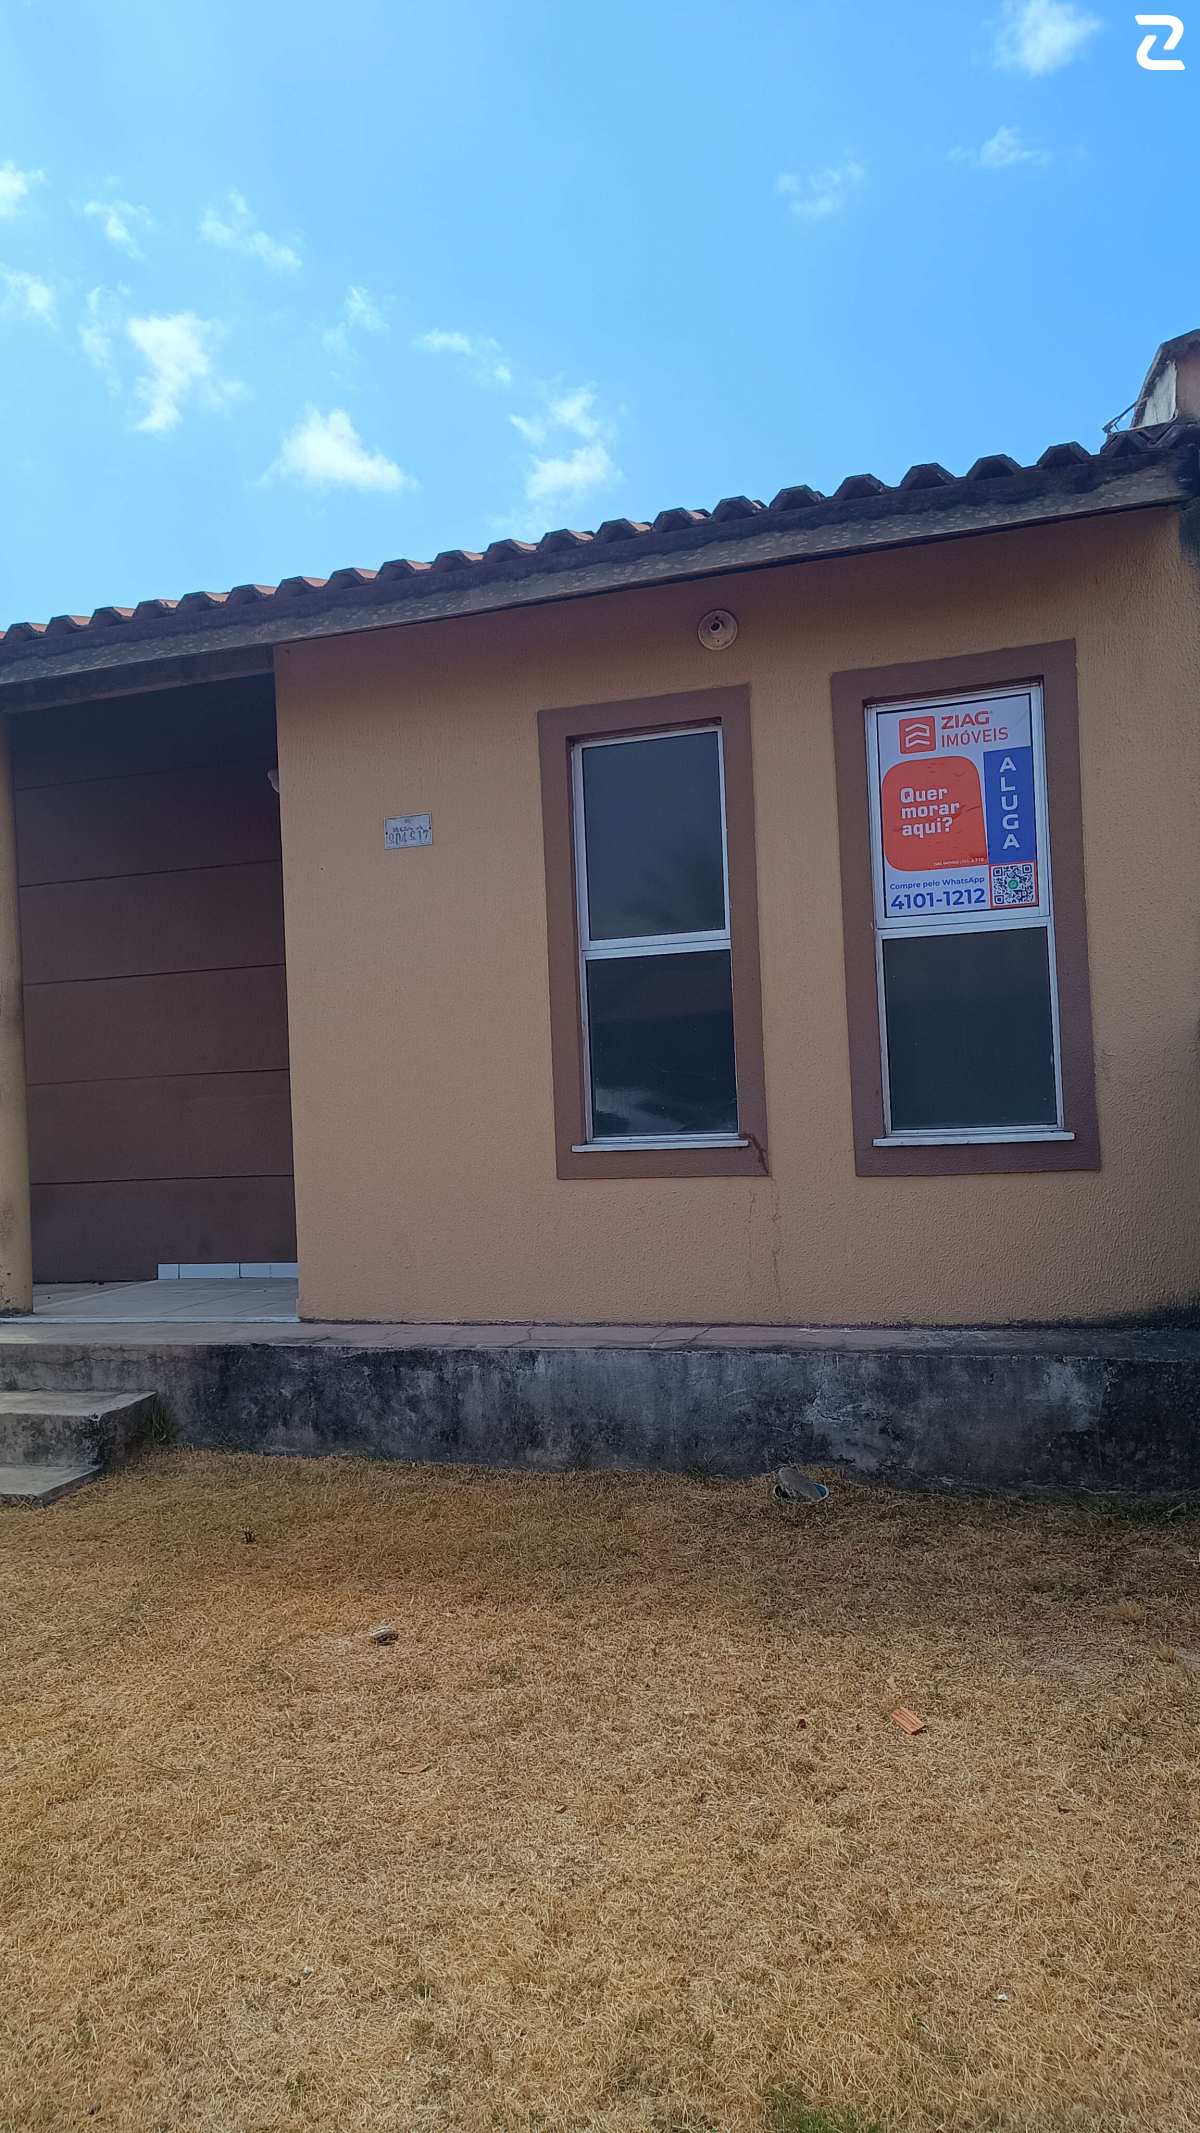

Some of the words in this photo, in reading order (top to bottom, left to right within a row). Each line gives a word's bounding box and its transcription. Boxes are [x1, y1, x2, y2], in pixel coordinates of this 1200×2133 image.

[941, 711, 990, 730] ZIAG
[941, 727, 1009, 748] IMÓVEIS
[900, 787, 948, 803] Quer
[999, 756, 1020, 850] ALUGA
[901, 801, 960, 819] morar
[902, 817, 953, 838] aqui?
[889, 882, 921, 890] Compre
[922, 879, 941, 888] pelo
[942, 876, 985, 886] WhatsApp
[890, 887, 987, 910] 4101-1212
